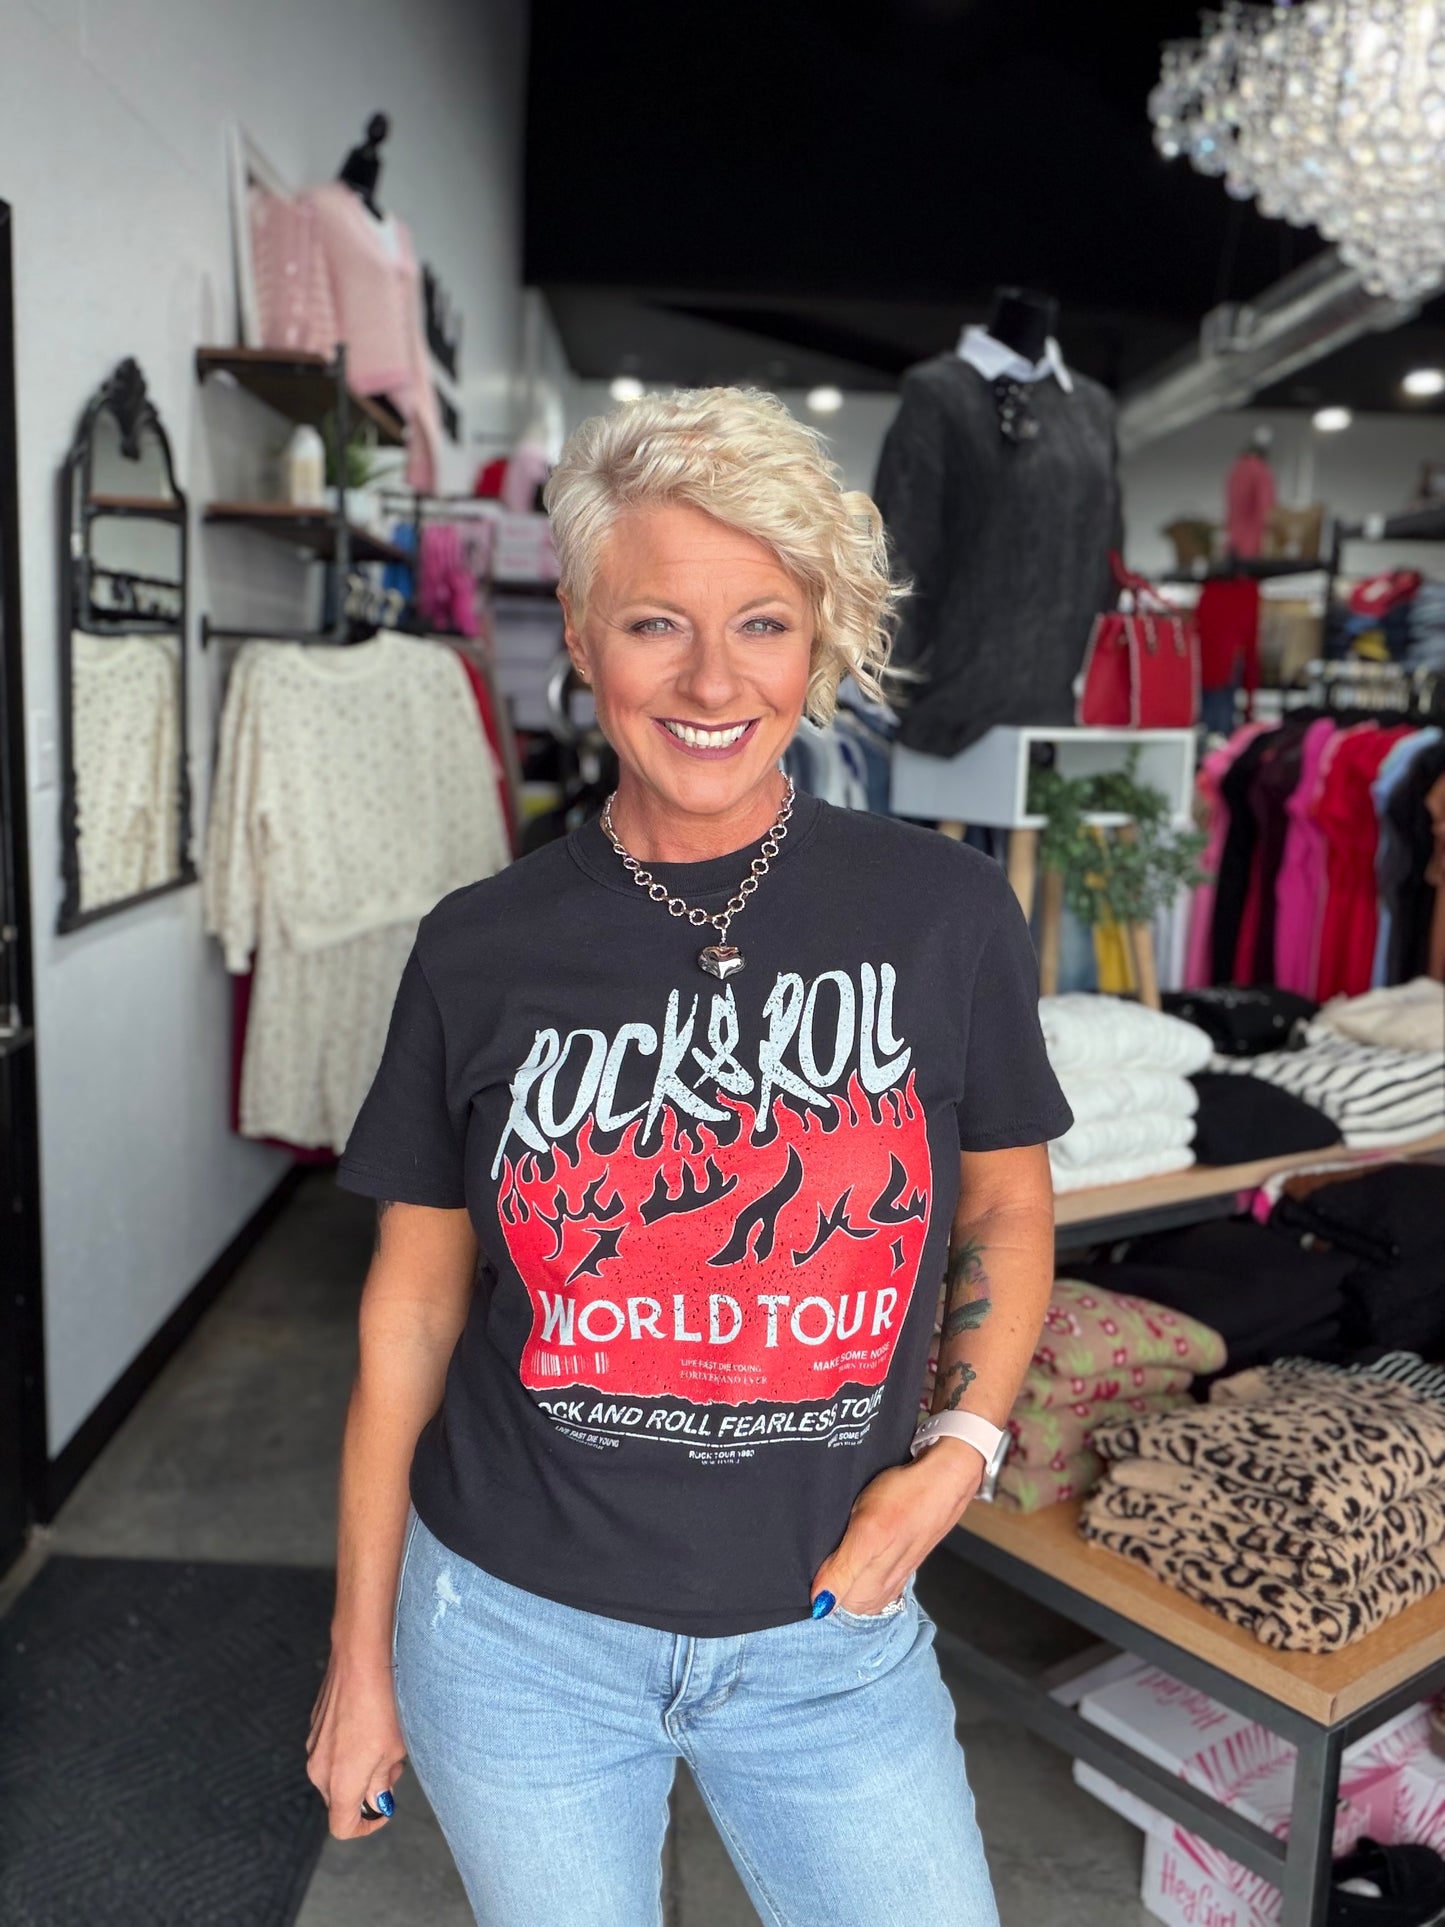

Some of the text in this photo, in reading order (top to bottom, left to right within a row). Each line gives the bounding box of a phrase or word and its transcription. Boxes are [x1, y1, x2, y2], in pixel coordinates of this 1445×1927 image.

[490, 988, 731, 1181] ROCK
[756, 962, 912, 1132] ROLL
[537, 1286, 898, 1348] WORLD TOUR
[813, 1356, 840, 1371] MAKE
[840, 1350, 868, 1362] SOME
[587, 1402, 644, 1425] AND
[645, 1409, 712, 1436] ROLL
[719, 1403, 838, 1438] FEARLESS
[840, 1385, 885, 1419] TOUR
[1160, 1851, 1197, 1924] Hey
